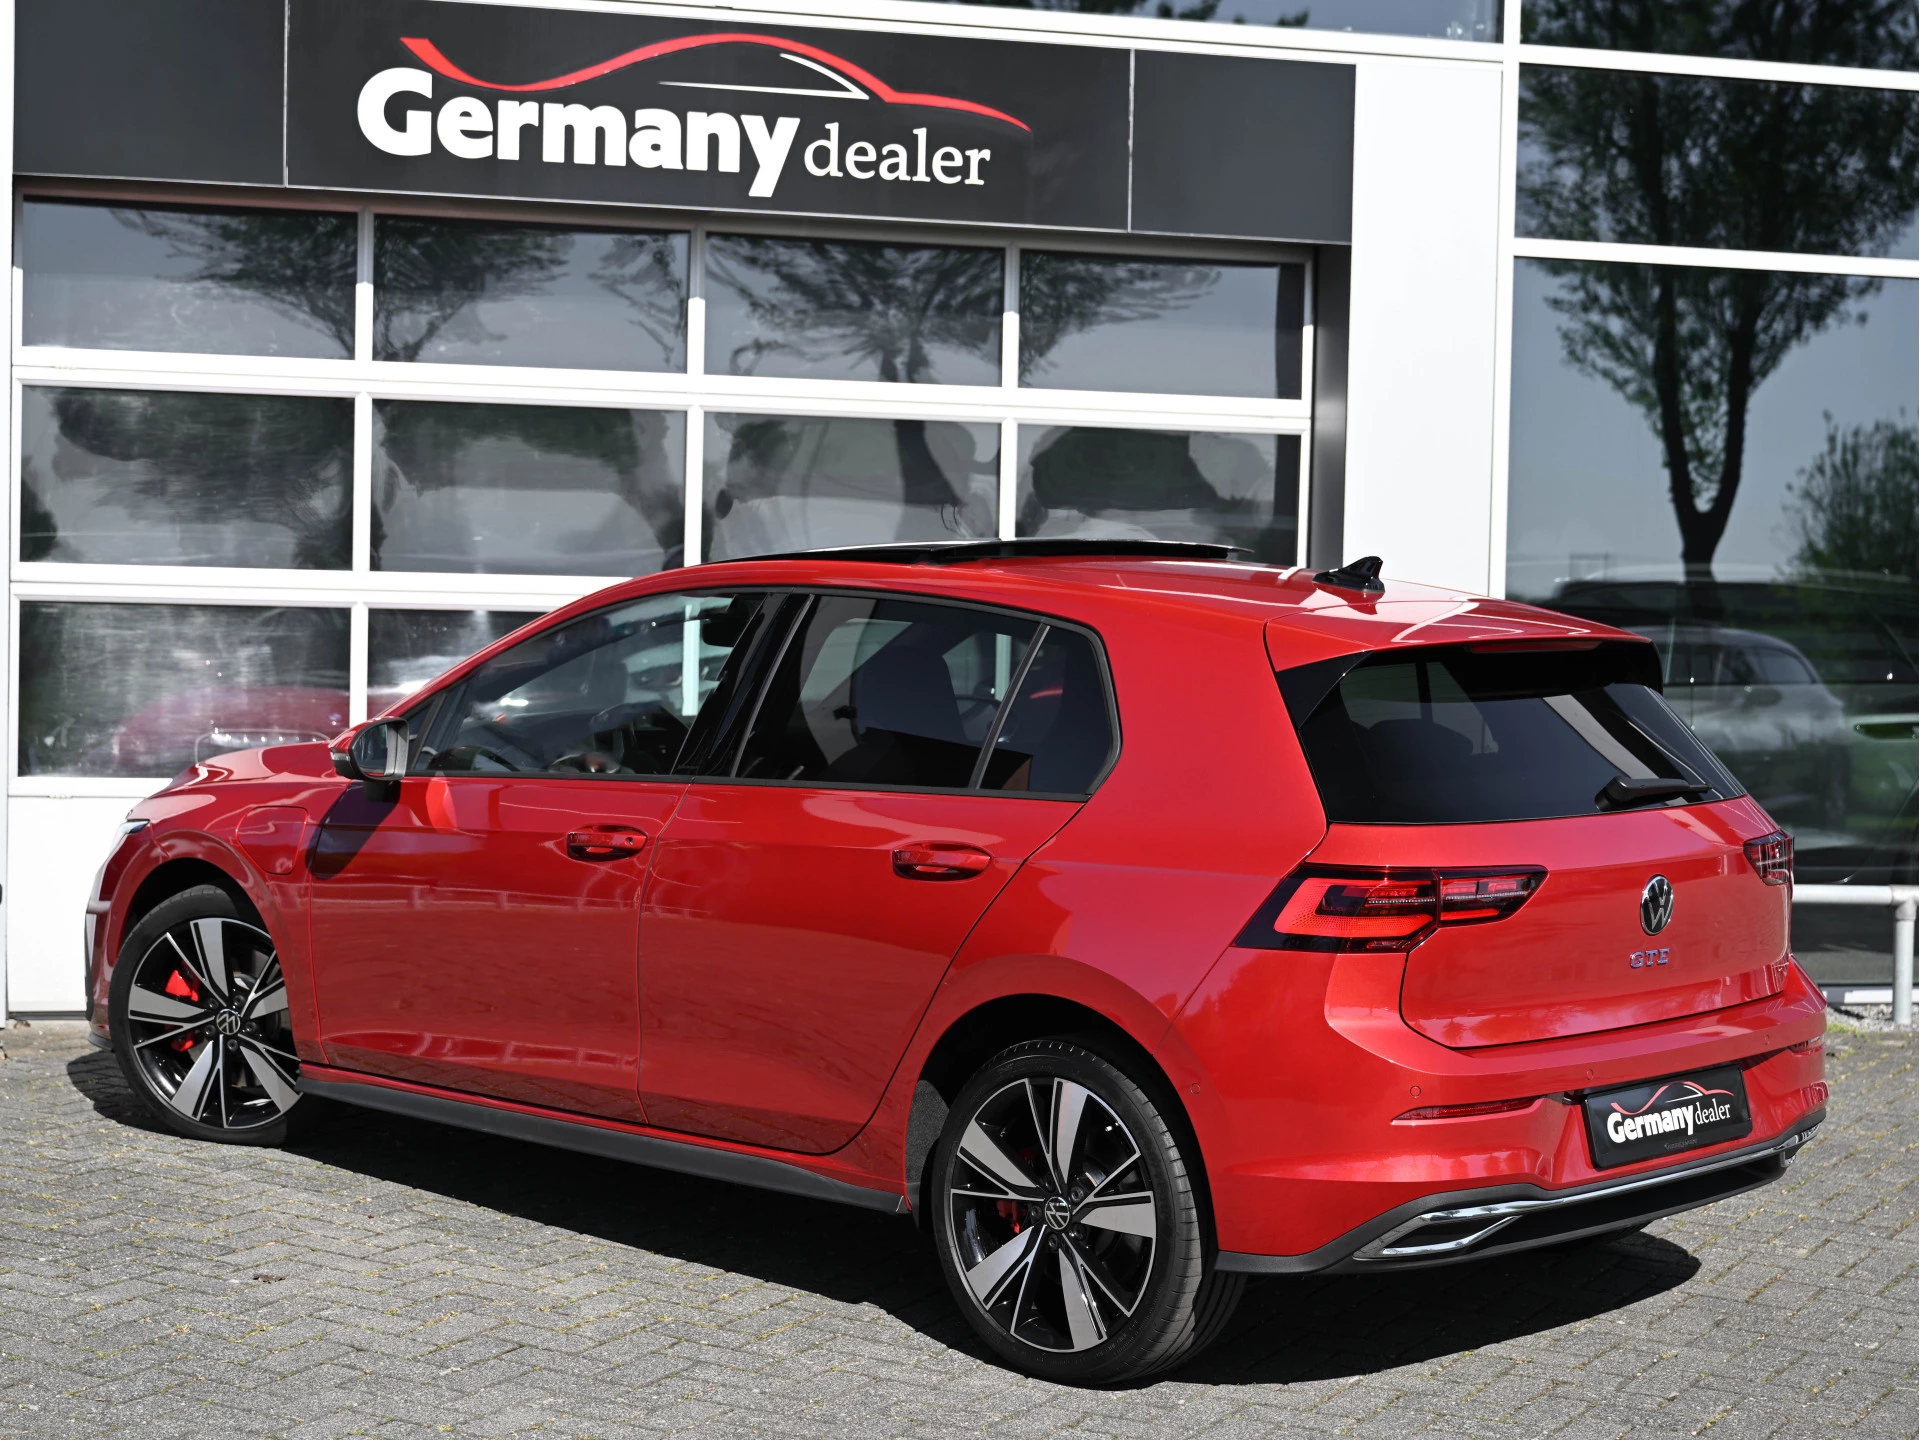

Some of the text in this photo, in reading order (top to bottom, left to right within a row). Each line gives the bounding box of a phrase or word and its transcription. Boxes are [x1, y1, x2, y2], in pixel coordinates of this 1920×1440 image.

[357, 67, 991, 197] Germany dealer
[1630, 948, 1670, 969] GTE
[1607, 1098, 1731, 1144] Germany dealer
